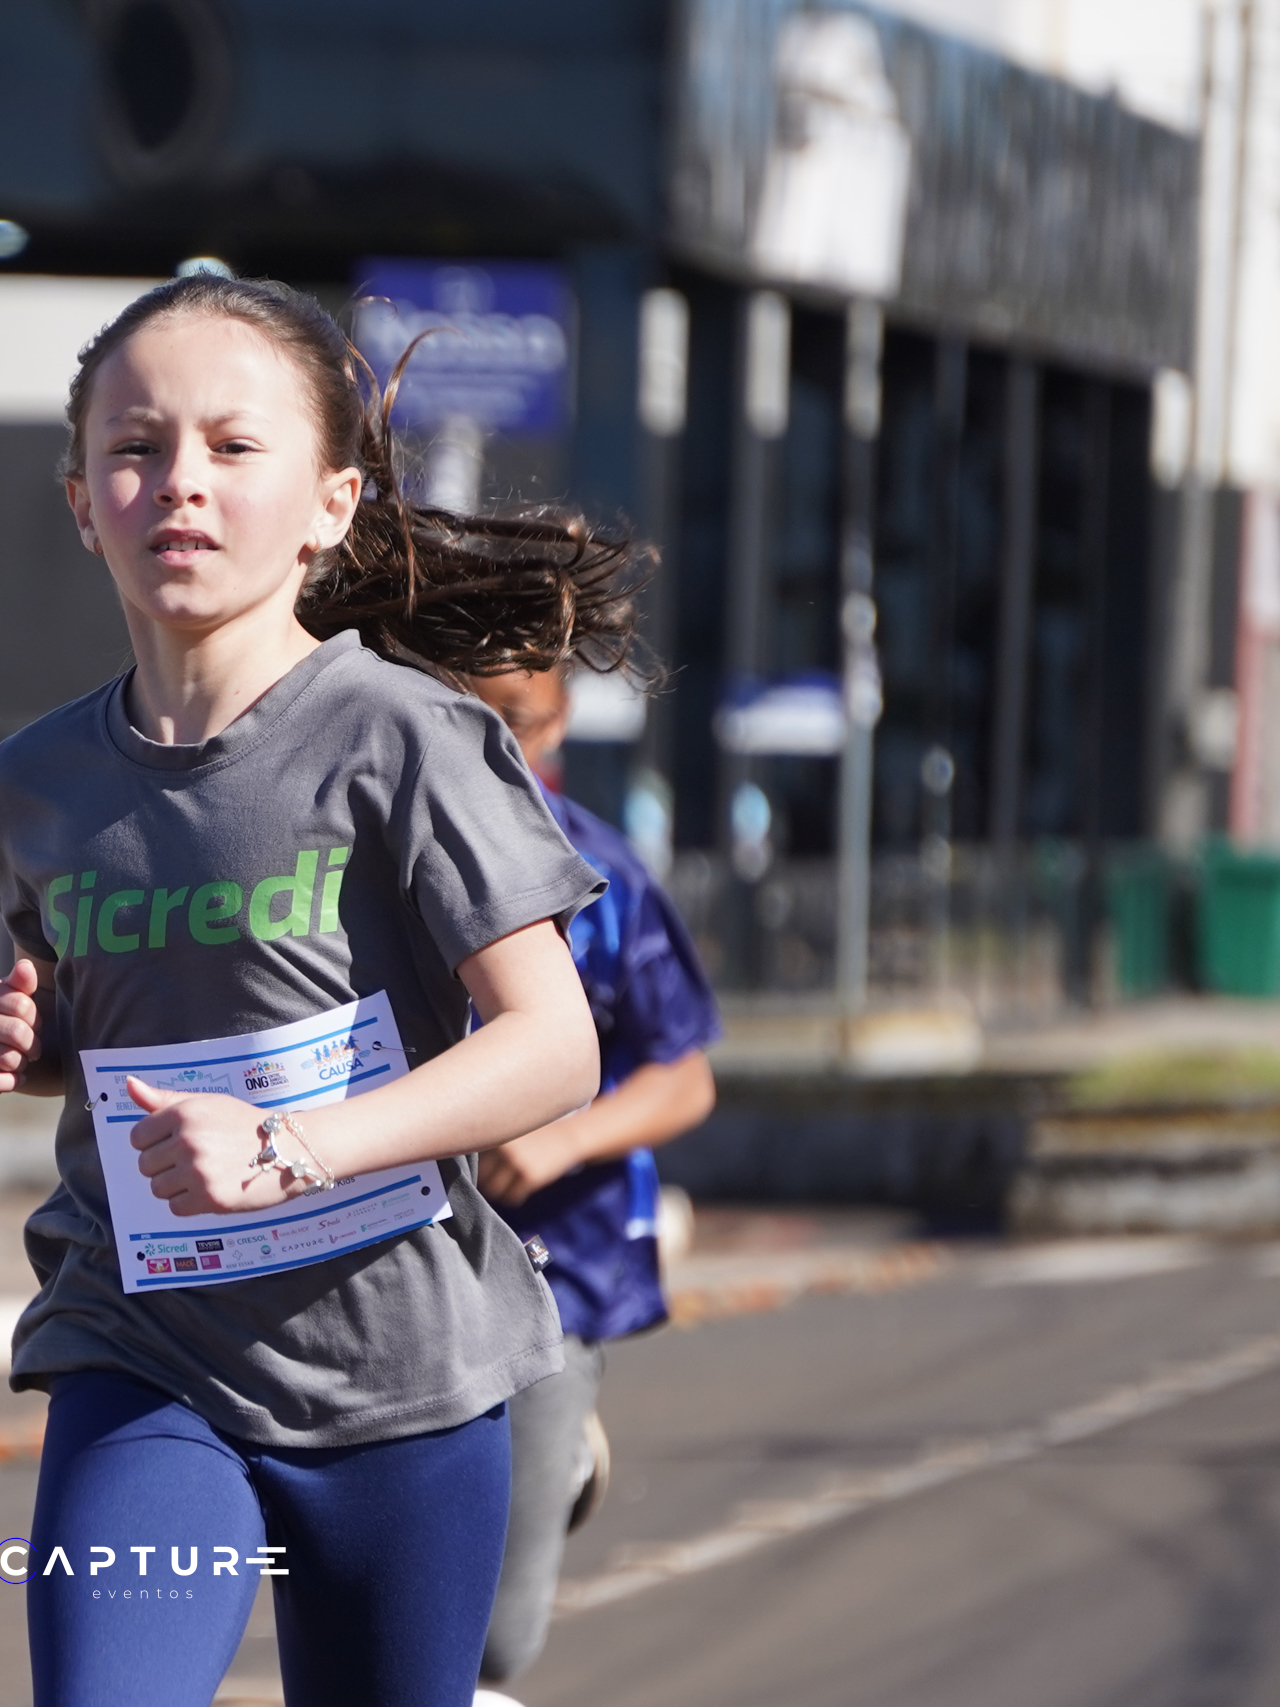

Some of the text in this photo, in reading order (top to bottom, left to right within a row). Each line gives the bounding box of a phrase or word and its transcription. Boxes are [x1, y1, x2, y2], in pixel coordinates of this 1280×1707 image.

[47, 847, 348, 960] Sicredi
[319, 1058, 364, 1080] CAUSA
[245, 1075, 269, 1091] ONG
[236, 1234, 269, 1246] CRESOL
[281, 1238, 324, 1252] CAPTURE
[157, 1243, 188, 1254] Sicredi
